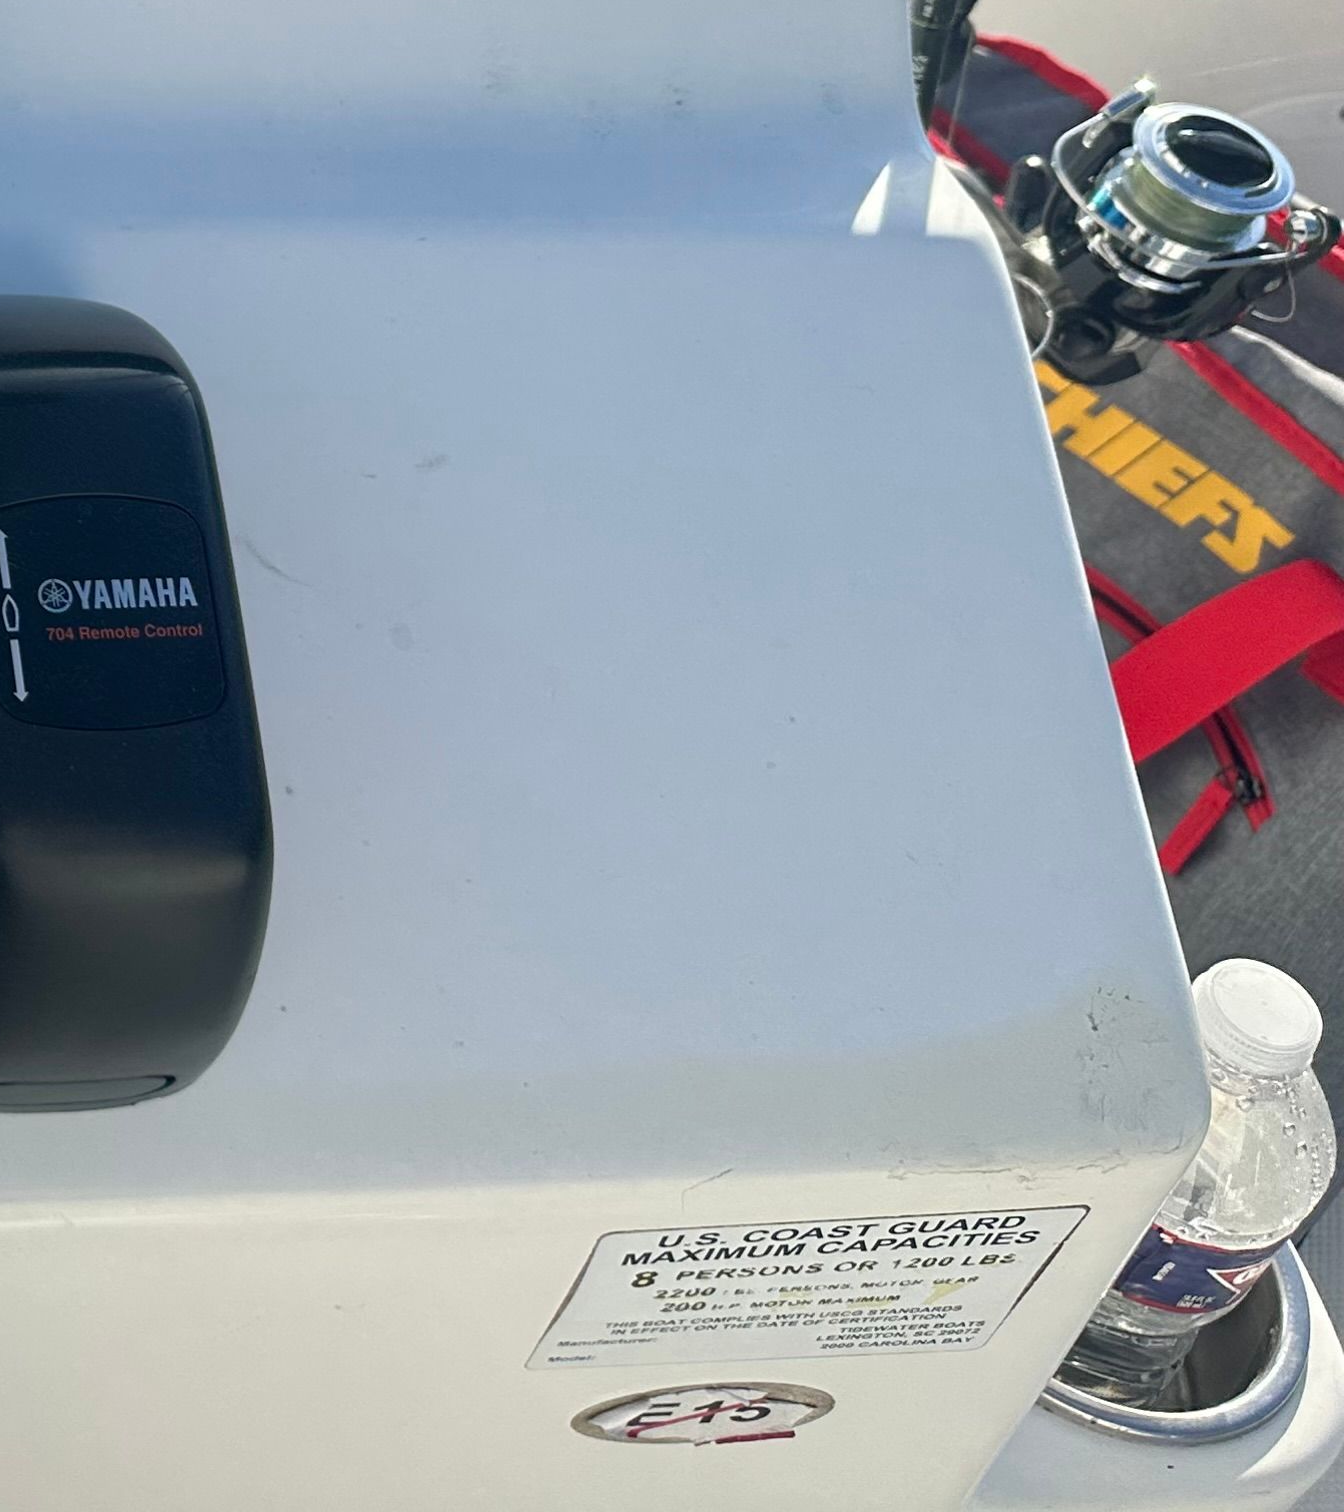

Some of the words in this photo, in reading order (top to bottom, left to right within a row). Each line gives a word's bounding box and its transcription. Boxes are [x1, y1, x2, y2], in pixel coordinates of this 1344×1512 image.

[73, 577, 198, 610] YAMAHA
[45, 627, 74, 641] 704
[80, 625, 139, 641] Remote
[144, 623, 203, 639] Control
[659, 1232, 726, 1248] U.S.
[742, 1224, 879, 1244] COAST
[889, 1216, 1026, 1235] GUARD
[621, 1243, 806, 1266] MAXIMUM
[817, 1231, 1041, 1254] CAPACITIES
[631, 1271, 659, 1288] 8
[676, 1263, 824, 1281] PERSONS
[834, 1259, 878, 1273] OR
[892, 1256, 954, 1270] 1200
[660, 1301, 706, 1313] 200
[818, 1295, 901, 1306] MAXIMUM
[606, 1320, 638, 1328] THIS
[642, 1318, 686, 1327] BOAT
[690, 1314, 771, 1324] COMPLIES
[776, 1311, 815, 1320] WITH
[819, 1309, 863, 1318] USCG
[867, 1305, 962, 1316] STANDARDS
[611, 1328, 627, 1336] IN
[631, 1325, 691, 1335] EFFECT
[694, 1323, 717, 1332] ON
[722, 1322, 754, 1330] THE
[756, 1319, 800, 1328] DATE
[803, 1318, 824, 1326] OF
[828, 1313, 948, 1325] CERTIFICATION
[840, 1324, 930, 1334] TIDEWATER
[933, 1320, 985, 1329] BOATS
[913, 1329, 935, 1337] SC
[557, 1337, 659, 1348] Manufacturer:
[859, 1338, 937, 1349] CAROLINA
[941, 1336, 976, 1345] BAY
